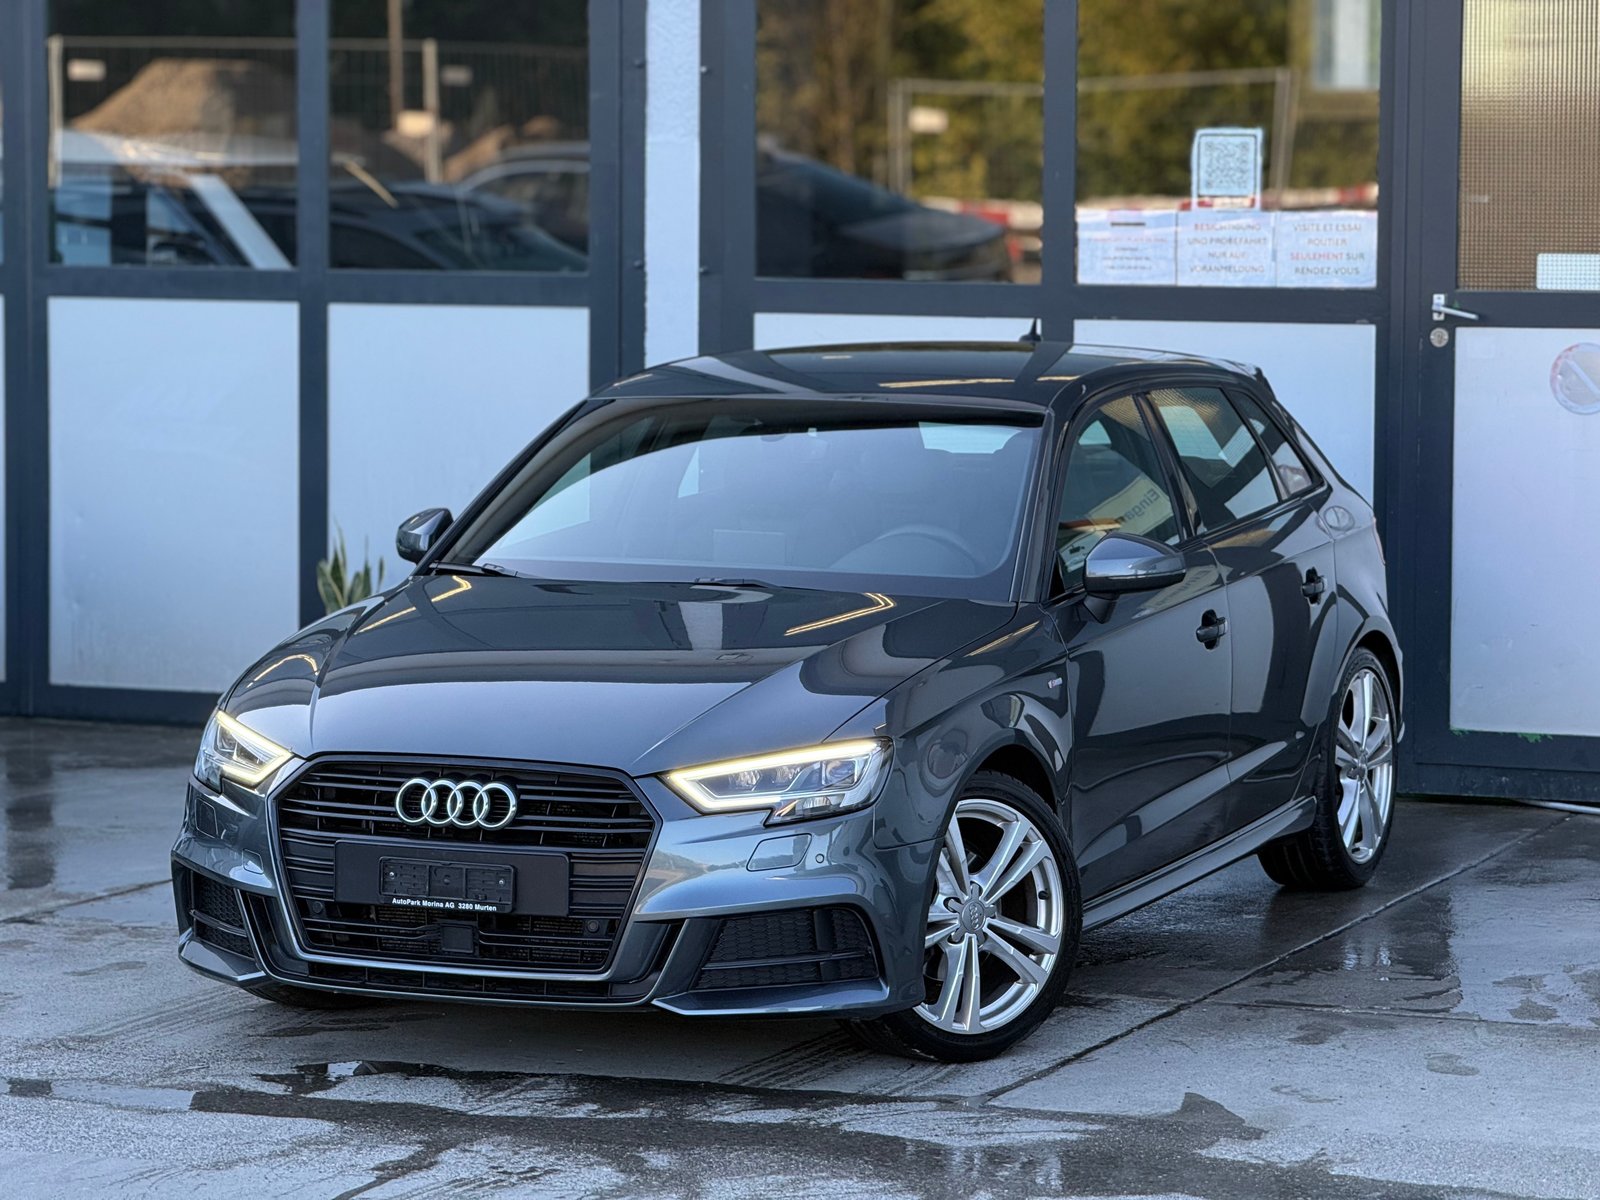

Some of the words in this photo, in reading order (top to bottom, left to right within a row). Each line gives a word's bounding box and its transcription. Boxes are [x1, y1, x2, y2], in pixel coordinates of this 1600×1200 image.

[1290, 252, 1344, 260] SEULEMENT
[1345, 252, 1365, 260] SUR
[1189, 264, 1265, 273] VORANMELDUNG
